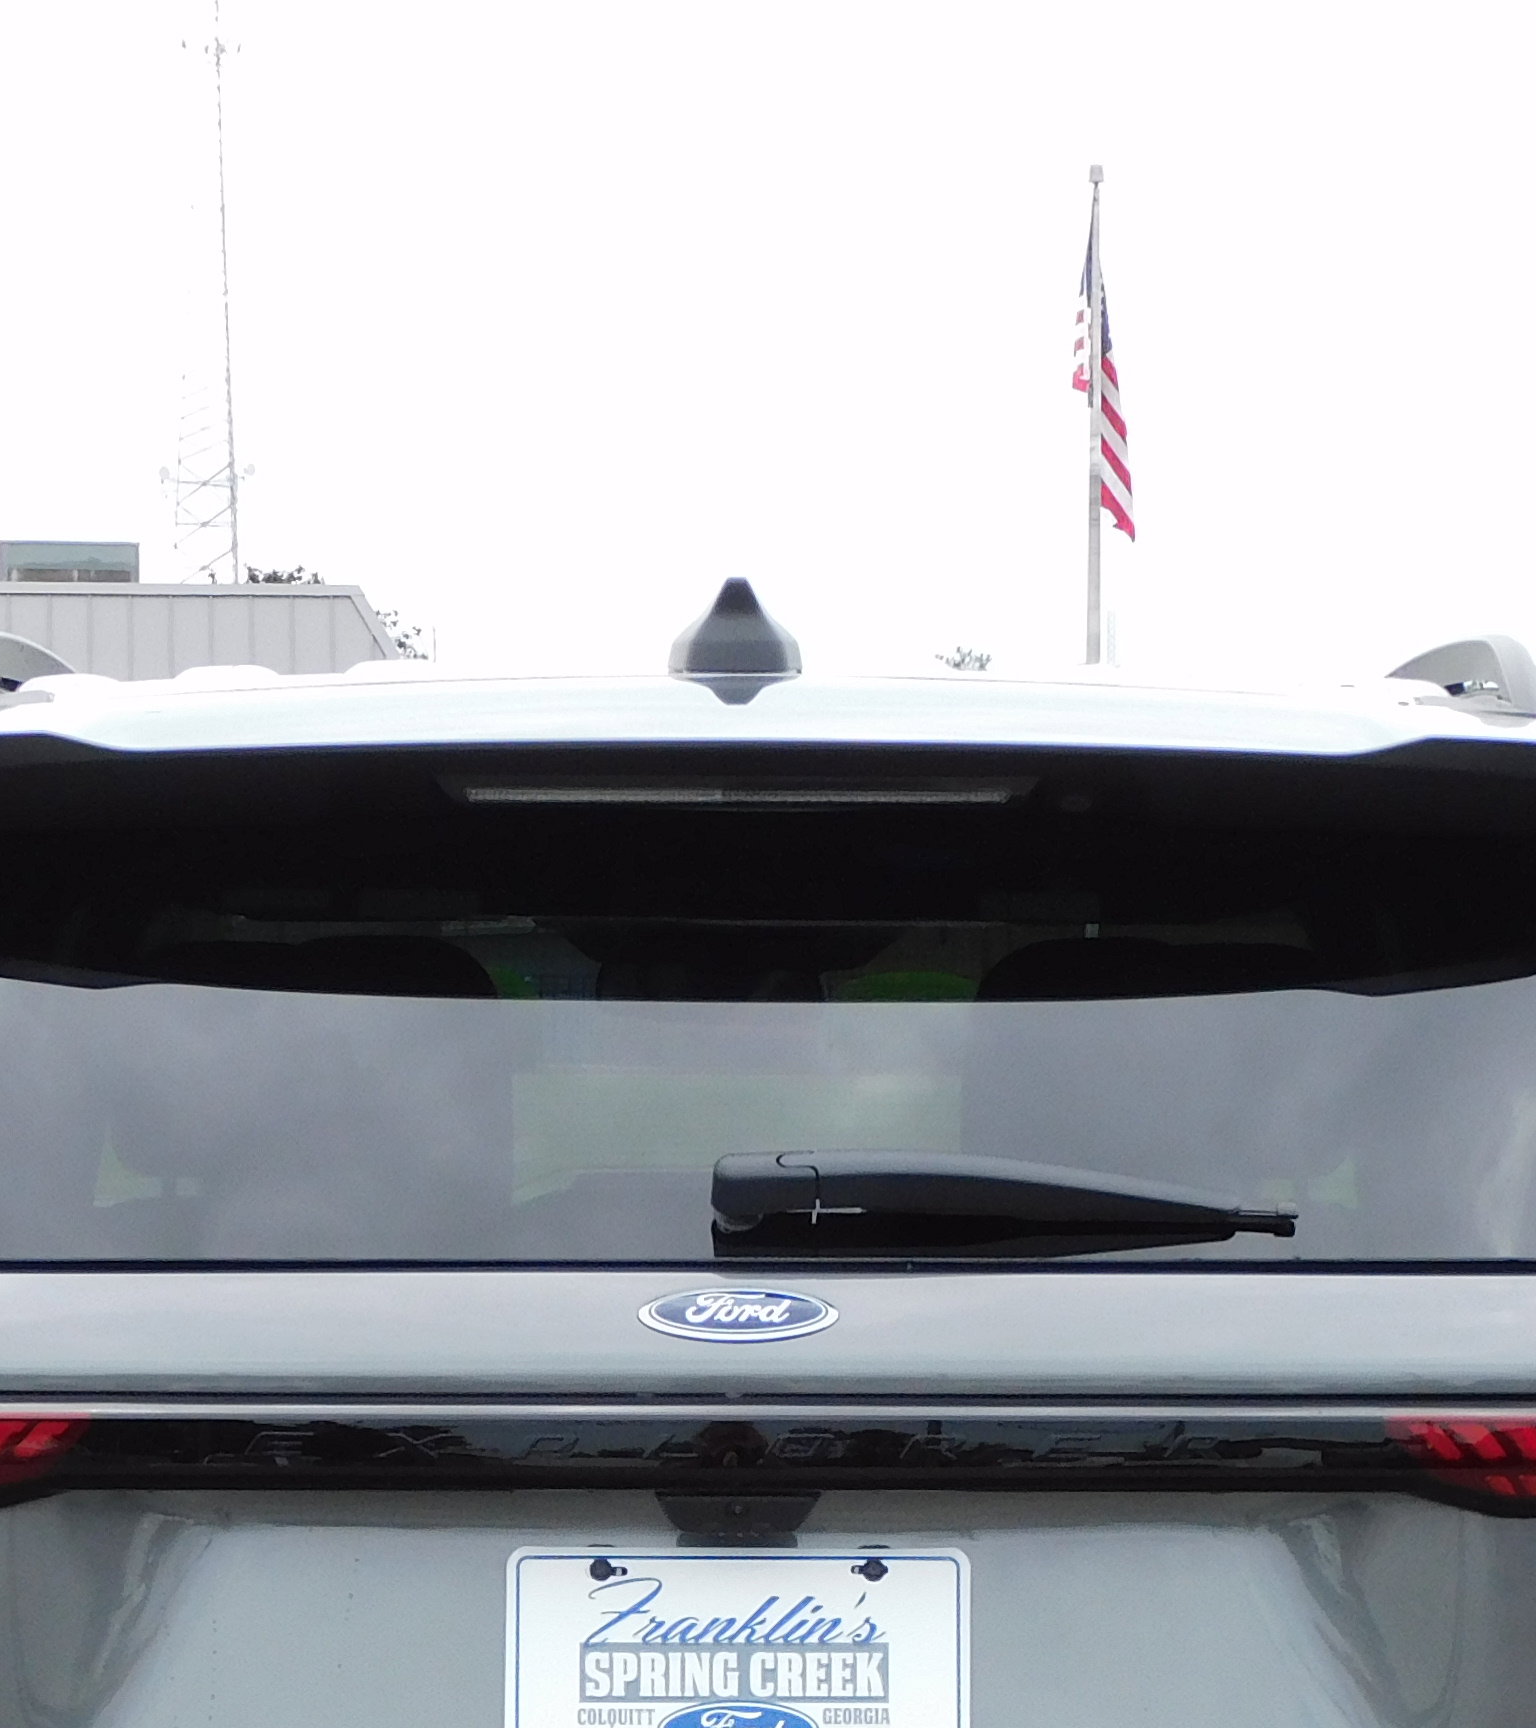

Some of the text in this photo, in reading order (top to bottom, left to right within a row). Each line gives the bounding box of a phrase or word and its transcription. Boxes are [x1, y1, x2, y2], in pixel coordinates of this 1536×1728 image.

[685, 1292, 792, 1323] Ford
[585, 1577, 887, 1647] Franklin's
[584, 1651, 885, 1698] SPRING CREEK
[577, 1707, 656, 1728] COLQUITT
[822, 1707, 891, 1726] GEORGIA
